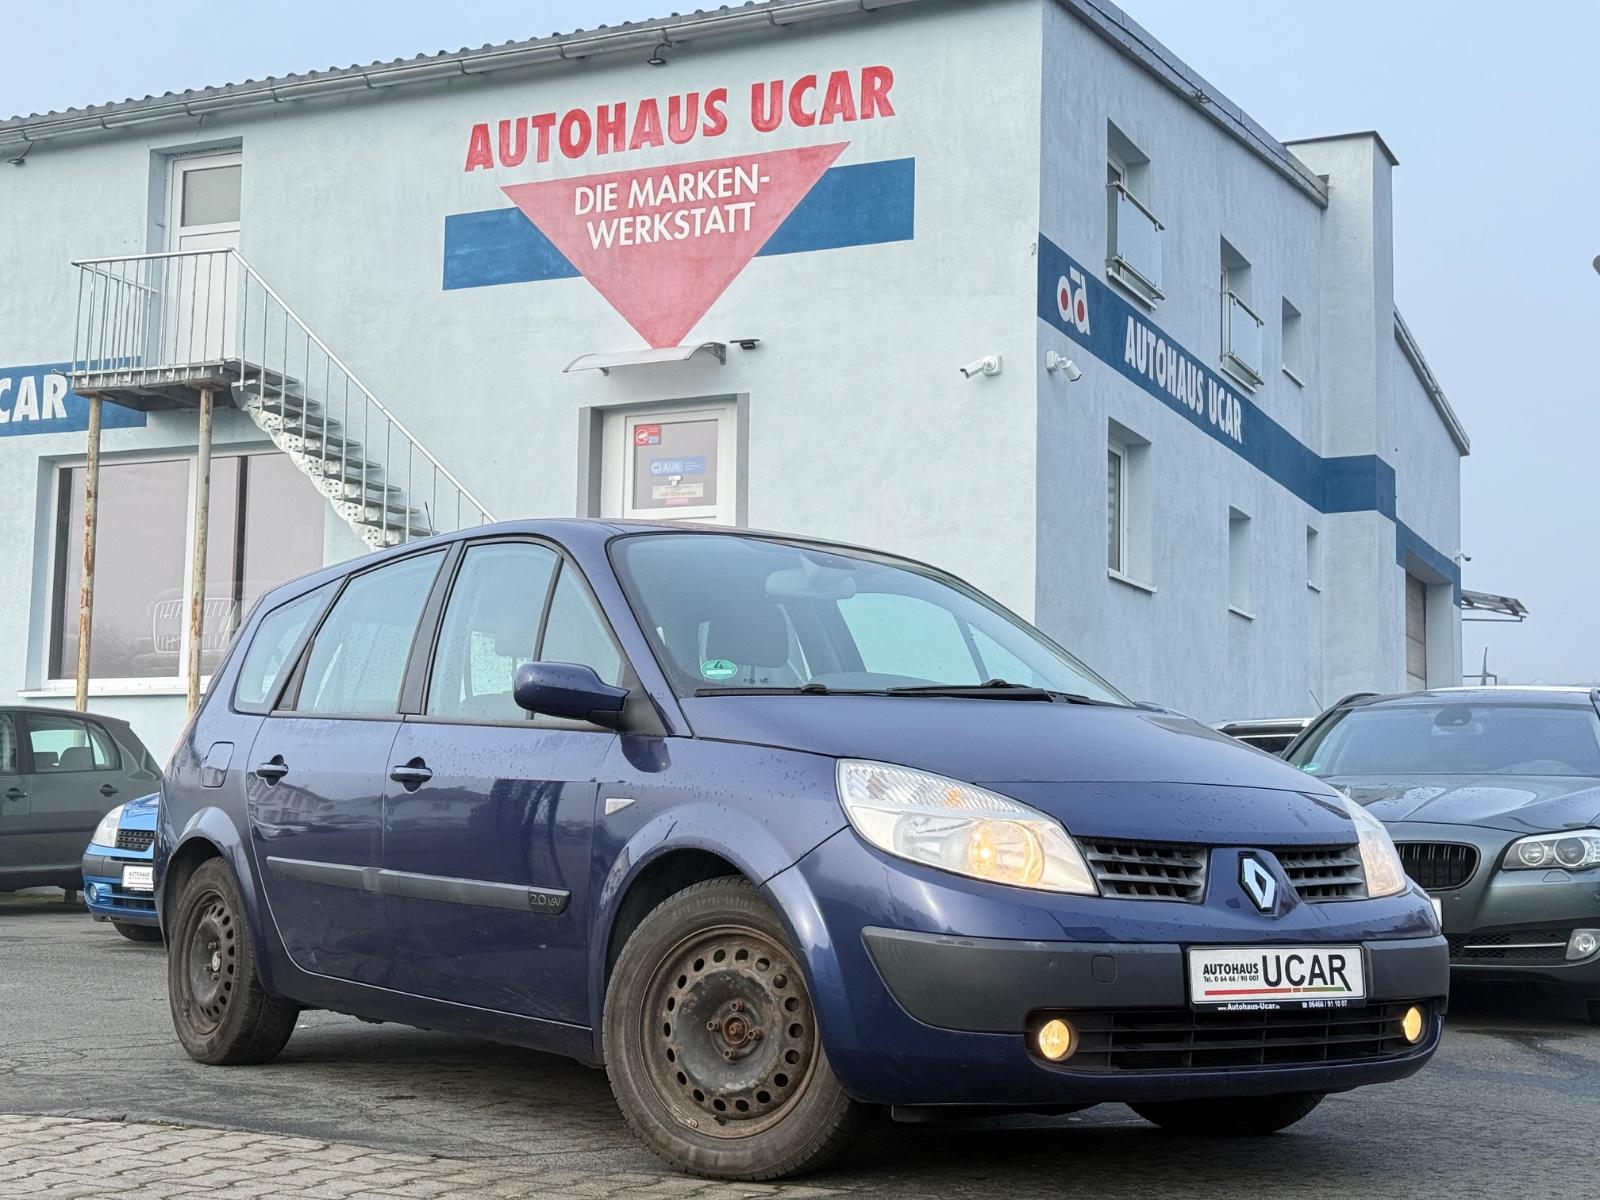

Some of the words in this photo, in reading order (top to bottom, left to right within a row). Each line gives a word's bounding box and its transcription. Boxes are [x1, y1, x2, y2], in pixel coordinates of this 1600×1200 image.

[464, 88, 728, 172] AUTOHAUS
[751, 65, 897, 133] UCAR
[574, 182, 618, 217] DIE
[628, 164, 770, 209] MARKEN-
[587, 202, 756, 250] WERKSTATT
[1124, 315, 1204, 416] AUTOHAUS
[1208, 377, 1243, 444] UCAR
[1202, 963, 1259, 976] AUTOHAUS
[1262, 954, 1353, 992] UCAR
